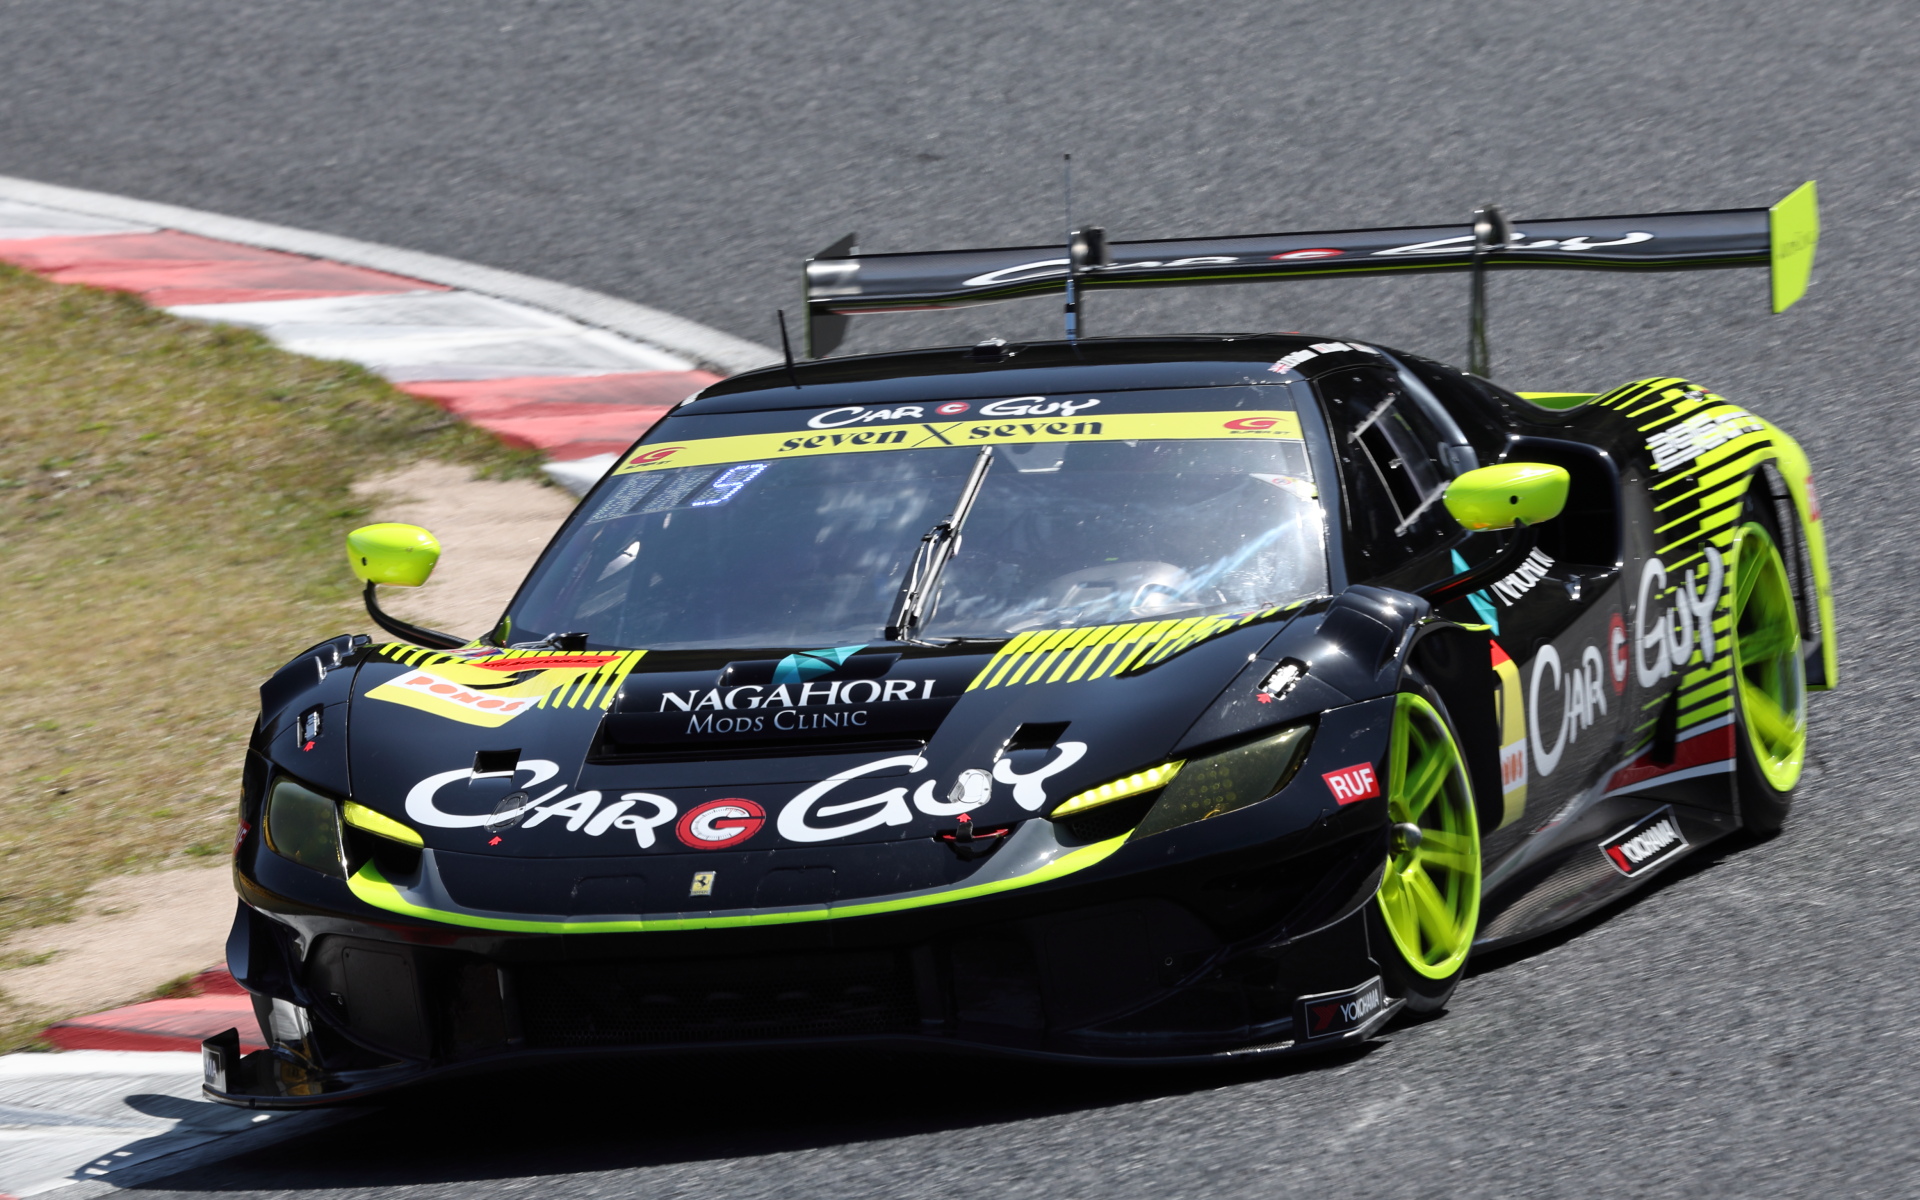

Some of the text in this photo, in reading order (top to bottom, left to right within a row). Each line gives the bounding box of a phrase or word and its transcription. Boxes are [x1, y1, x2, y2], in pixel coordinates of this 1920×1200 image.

[807, 406, 924, 429] CAR
[979, 395, 1101, 417] GUY
[776, 429, 909, 452] seven
[968, 421, 1104, 440] seven
[1529, 644, 1607, 777] CAR
[1635, 546, 1725, 688] GUY
[405, 675, 526, 713] PONOS
[659, 679, 936, 713] NAGAHORI
[685, 709, 867, 735] MODS CLINIC
[405, 760, 677, 849] CAR
[777, 742, 1088, 842] GUY
[1328, 768, 1374, 799] RUF
[1340, 988, 1380, 1023] YOKOHAMA
